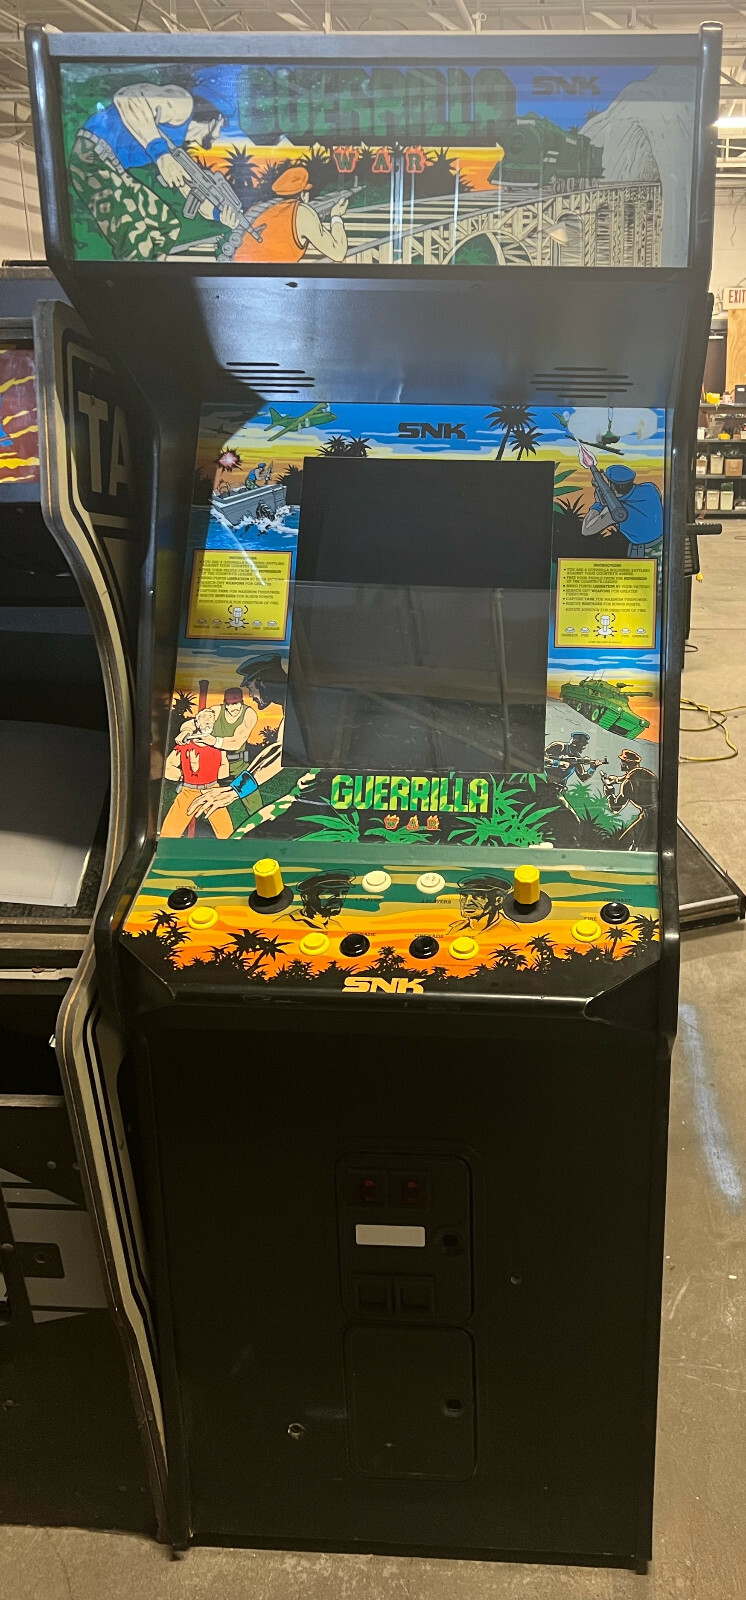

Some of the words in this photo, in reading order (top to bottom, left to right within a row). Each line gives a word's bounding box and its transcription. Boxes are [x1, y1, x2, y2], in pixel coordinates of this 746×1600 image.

[532, 75, 600, 96] SNK
[239, 66, 511, 139] GUERRILLA
[333, 146, 426, 173] WAR
[728, 289, 746, 304] EXIT
[397, 422, 467, 439] SNK
[331, 774, 489, 813] GUERRILLA
[383, 814, 440, 831] WAR
[341, 976, 427, 994] SNK
